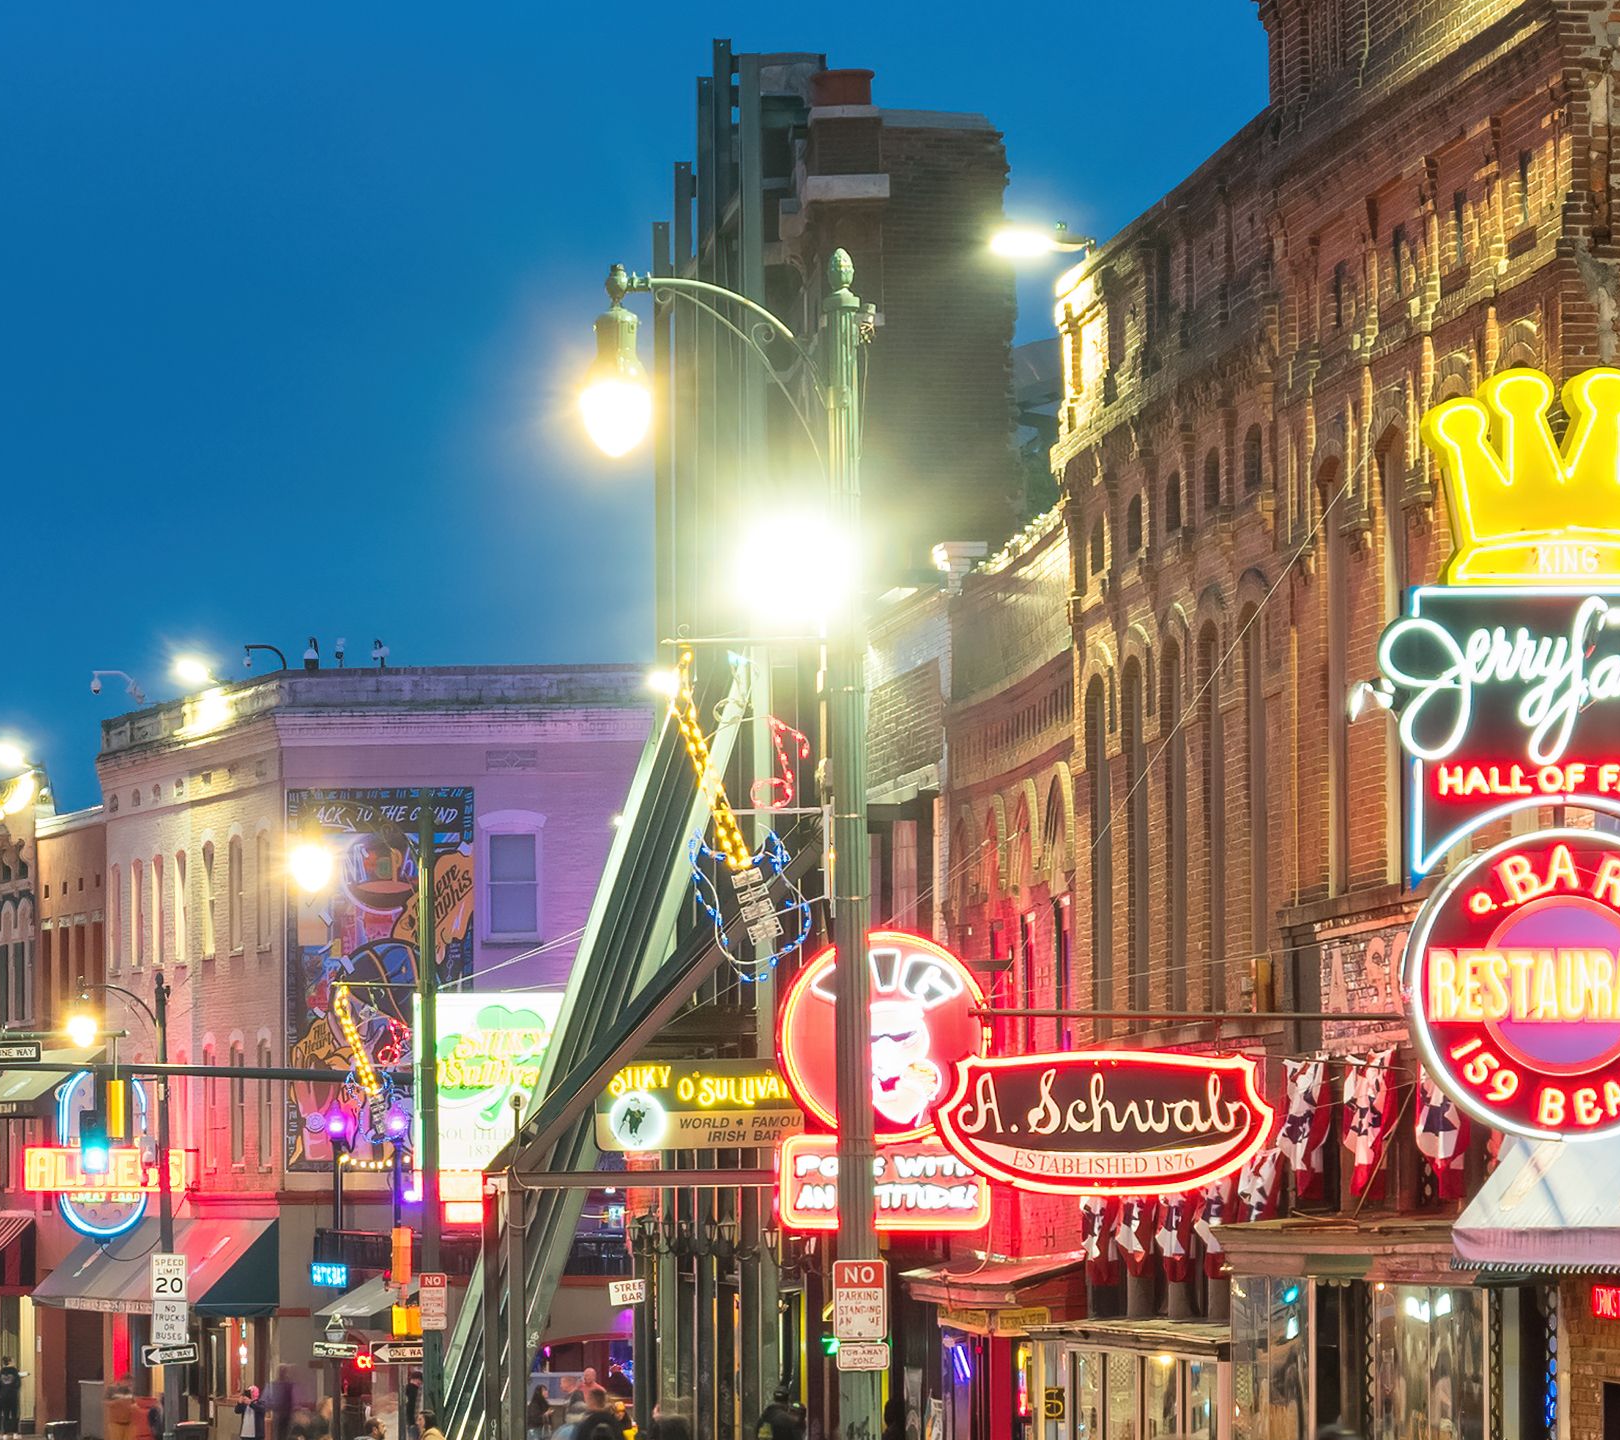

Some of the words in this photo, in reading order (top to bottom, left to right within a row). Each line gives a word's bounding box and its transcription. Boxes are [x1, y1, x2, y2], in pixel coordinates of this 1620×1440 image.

[1537, 547, 1598, 575] KING
[1378, 608, 1570, 762] Jerry
[1438, 764, 1532, 795] HALL
[1538, 764, 1584, 793] OF
[380, 805, 409, 823] THE
[16, 1047, 36, 1058] WAY
[1450, 1037, 1520, 1103] 159
[608, 1065, 672, 1097] SILKY
[959, 1072, 1018, 1133] A.
[1028, 1068, 1250, 1134] Schwab
[679, 1116, 730, 1129] WORLD
[751, 1115, 802, 1127] FAMOU
[706, 1130, 747, 1143] IRISH
[753, 1129, 782, 1142] BAR
[1012, 1150, 1150, 1176] ESTABLISHED
[1155, 1152, 1195, 1170] 1876
[155, 1258, 184, 1267] SPEED
[157, 1268, 181, 1276] LIMIT
[843, 1266, 876, 1284] NO
[155, 1277, 184, 1294] 20
[424, 1276, 441, 1286] NO
[613, 1282, 645, 1293] STREE
[621, 1292, 644, 1303] BAR
[838, 1291, 880, 1302] PARKING
[164, 1305, 177, 1313] NO
[155, 1313, 186, 1322] TRUCKS
[164, 1323, 175, 1331] OR
[155, 1332, 183, 1341] BUSES
[159, 1351, 175, 1360] ONE
[176, 1349, 193, 1359] WAY
[389, 1347, 407, 1358] ONE
[409, 1347, 424, 1356] WA
